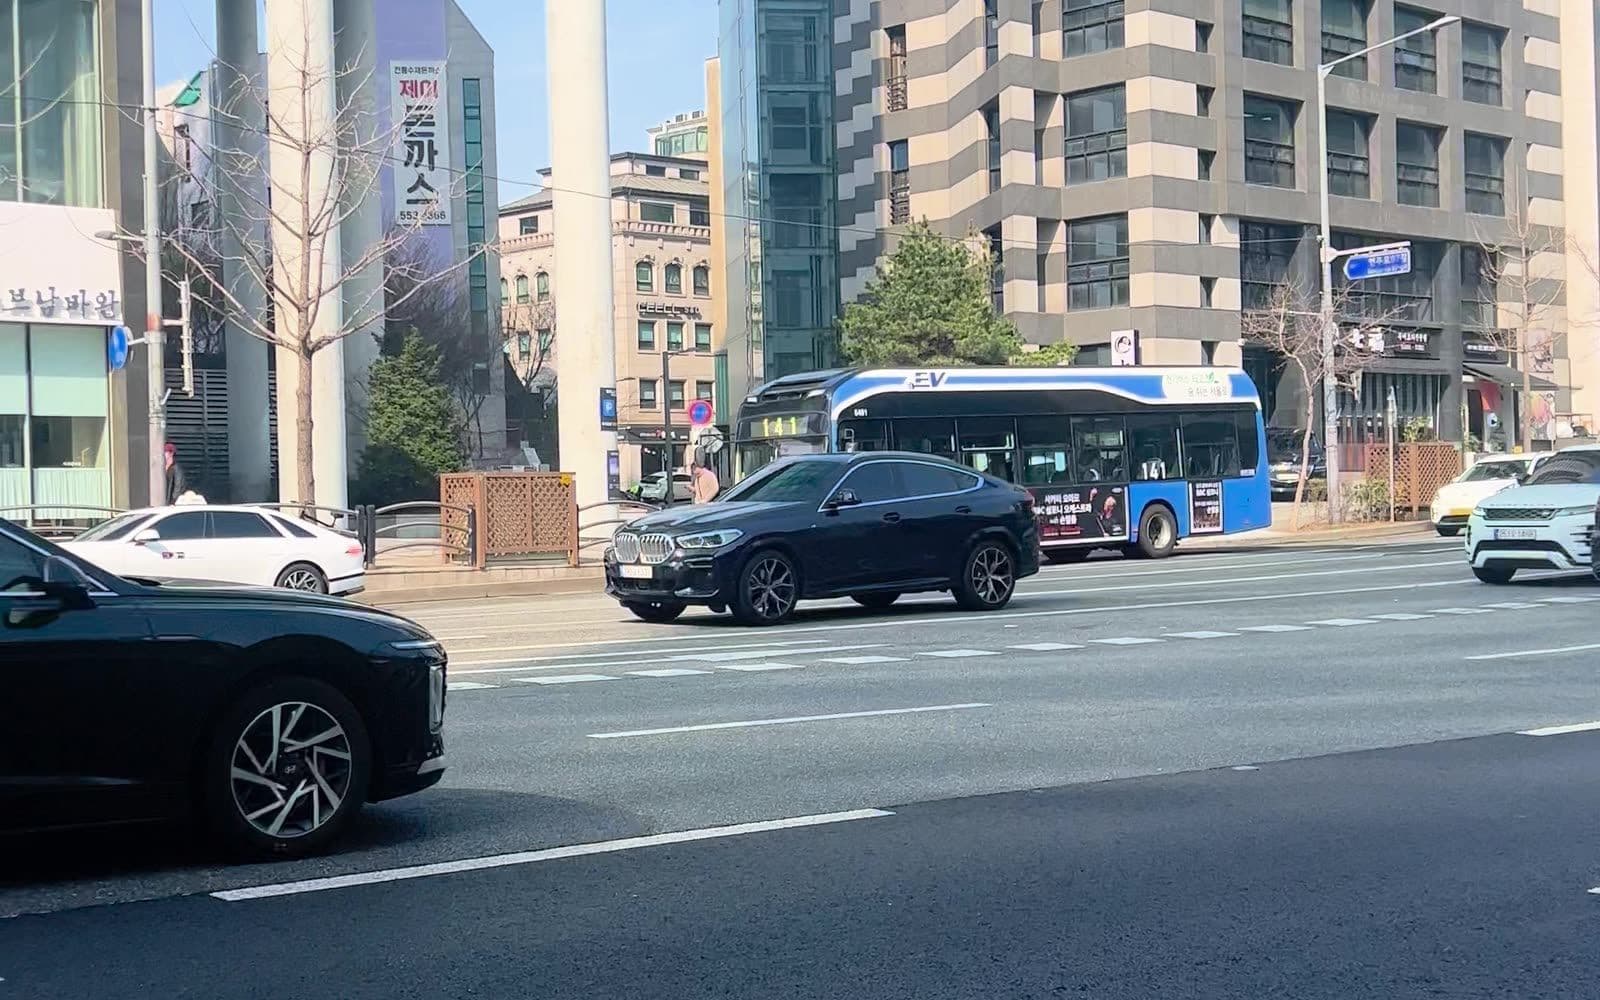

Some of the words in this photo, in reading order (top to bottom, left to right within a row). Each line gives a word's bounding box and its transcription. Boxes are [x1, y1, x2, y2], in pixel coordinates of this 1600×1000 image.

[914, 372, 946, 388] EV
[762, 417, 797, 437] 141
[1142, 461, 1166, 480] 141
